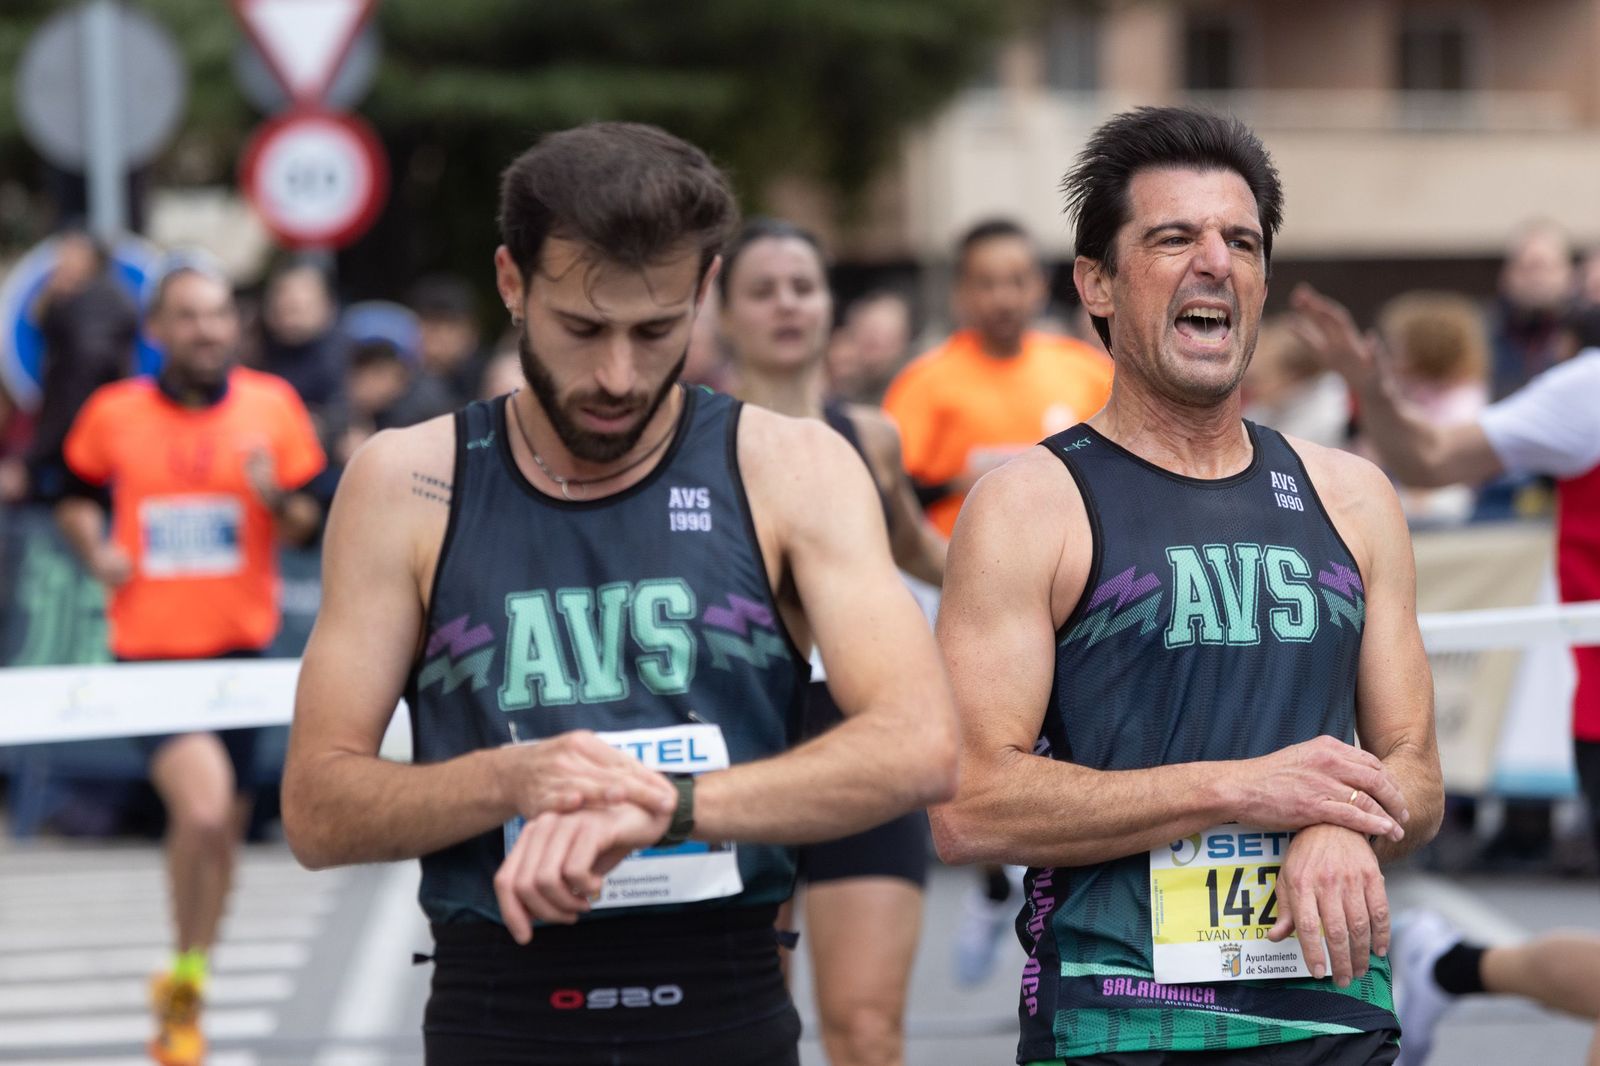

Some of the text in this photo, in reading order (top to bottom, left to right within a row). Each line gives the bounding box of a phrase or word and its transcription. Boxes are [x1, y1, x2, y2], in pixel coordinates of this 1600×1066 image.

[1270, 470, 1298, 493] AVS
[668, 486, 711, 509] AVS
[1274, 492, 1304, 511] 1990
[669, 511, 712, 532] 1990
[1164, 543, 1319, 649] AVS
[497, 577, 697, 711] AVS
[609, 737, 708, 763] TEL
[1206, 832, 1295, 859] SET
[1197, 929, 1230, 942] IVAN
[1239, 928, 1247, 939] Y
[1245, 952, 1297, 963] Ayuntamiento
[1246, 964, 1298, 974] de Salamanca
[1102, 977, 1216, 1004] SALAMANCA
